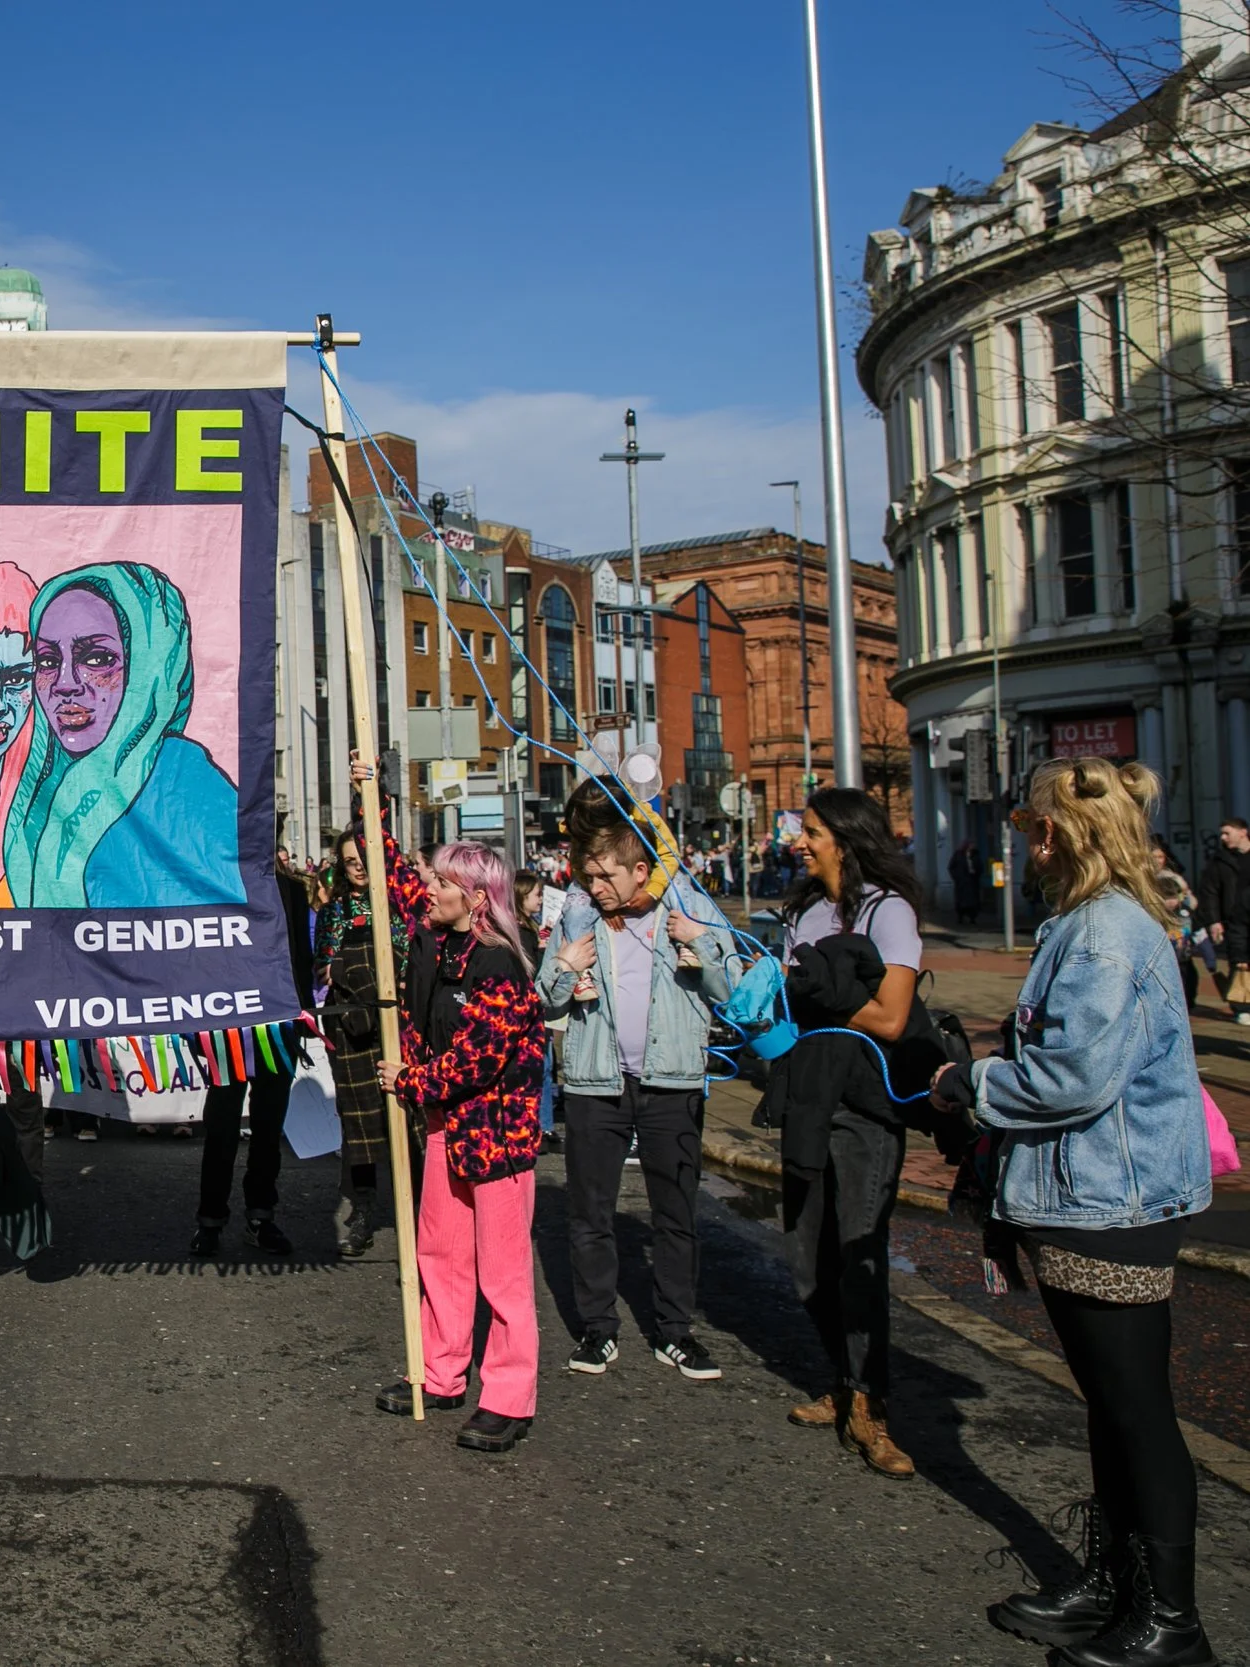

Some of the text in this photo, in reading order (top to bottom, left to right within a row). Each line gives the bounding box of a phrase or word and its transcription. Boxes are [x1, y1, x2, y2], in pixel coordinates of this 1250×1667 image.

[1053, 721, 1117, 742] TO LET
[74, 915, 253, 952] GENDER
[35, 988, 264, 1029] VIOLENCE
